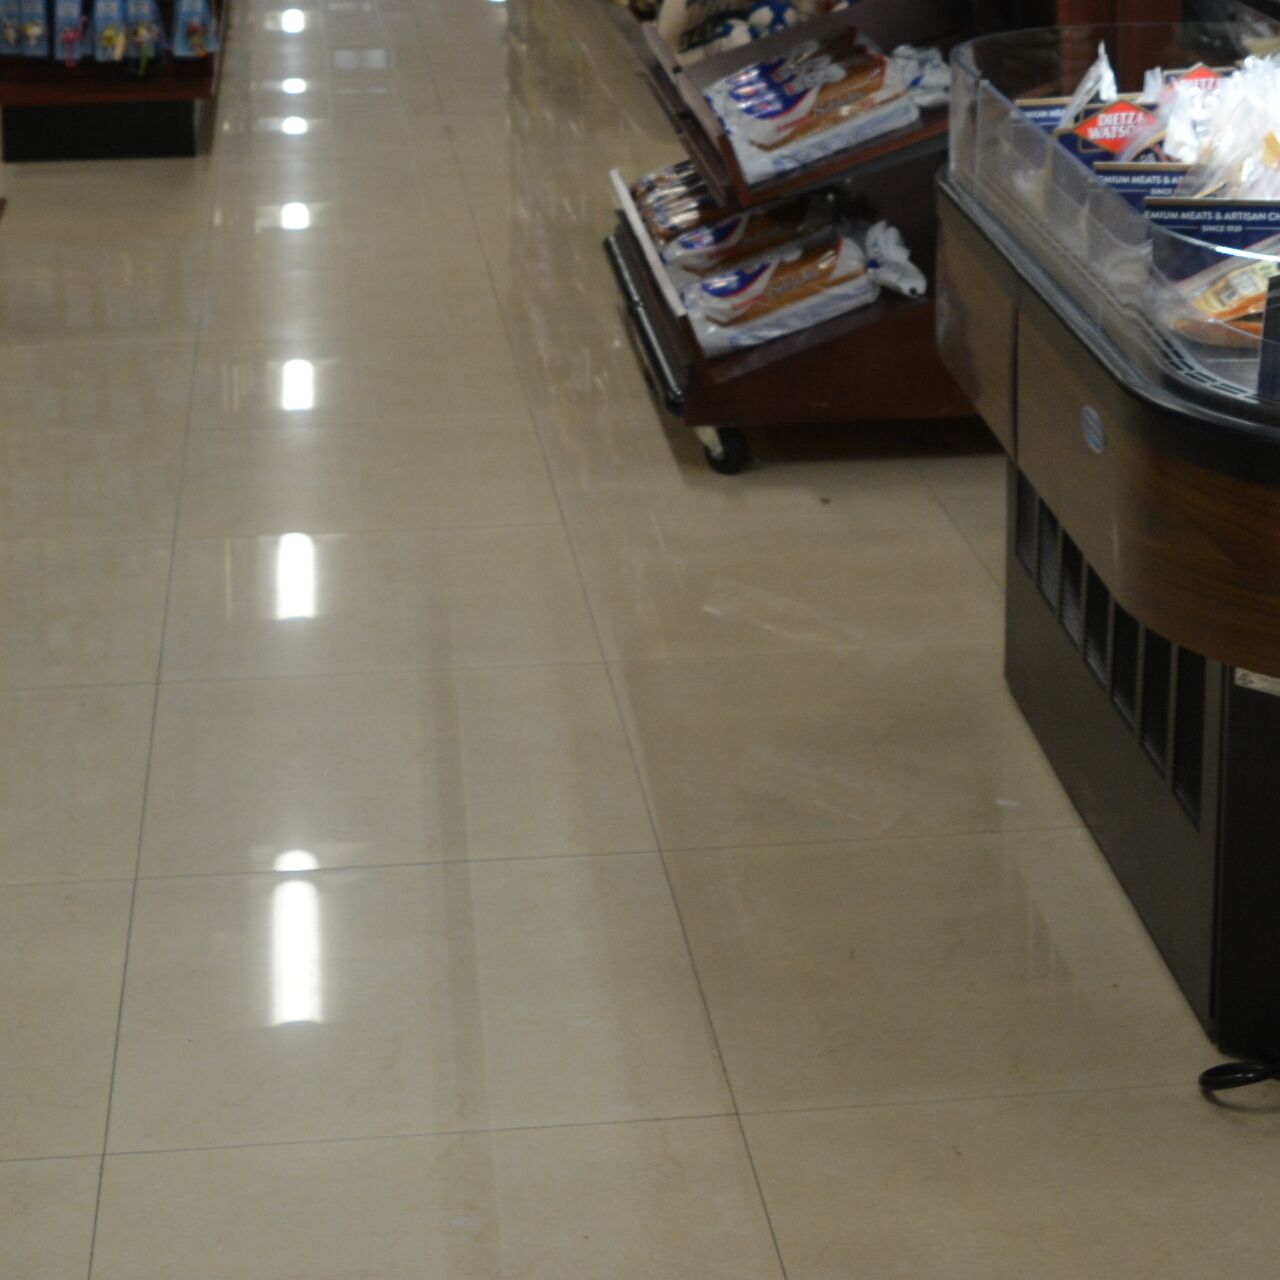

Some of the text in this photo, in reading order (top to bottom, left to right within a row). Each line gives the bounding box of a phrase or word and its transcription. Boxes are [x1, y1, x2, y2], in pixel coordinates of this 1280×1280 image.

[1097, 111, 1135, 127] DIETZ
[1136, 175, 1163, 185] MEATS
[1144, 210, 1179, 221] EMIUM
[1181, 210, 1214, 221] MEATS
[1223, 210, 1267, 222] ARTISAN
[1201, 224, 1225, 233] SINCE
